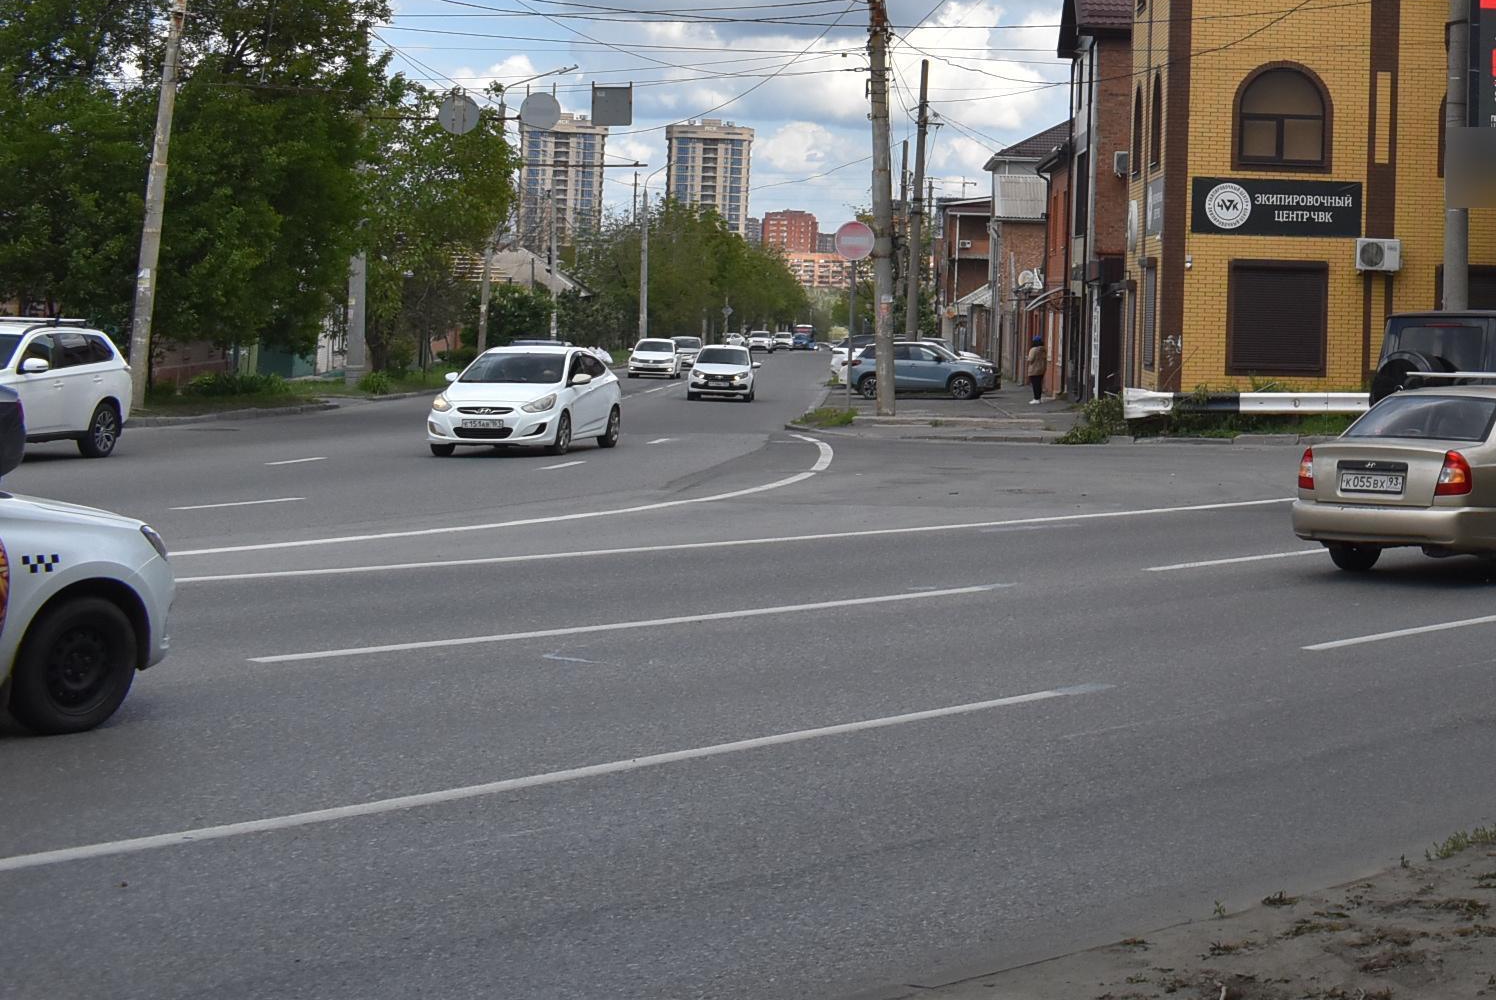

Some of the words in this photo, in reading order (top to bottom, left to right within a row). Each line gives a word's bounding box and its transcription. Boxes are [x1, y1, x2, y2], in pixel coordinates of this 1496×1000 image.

[1254, 193, 1353, 208] ЭКИПИРОВОЧНЫЙ
[1274, 210, 1310, 223] ЦЕНТР
[1310, 211, 1333, 223] ЧВК
[1345, 475, 1386, 489] К055ВХ
[1388, 477, 1399, 486] 93
